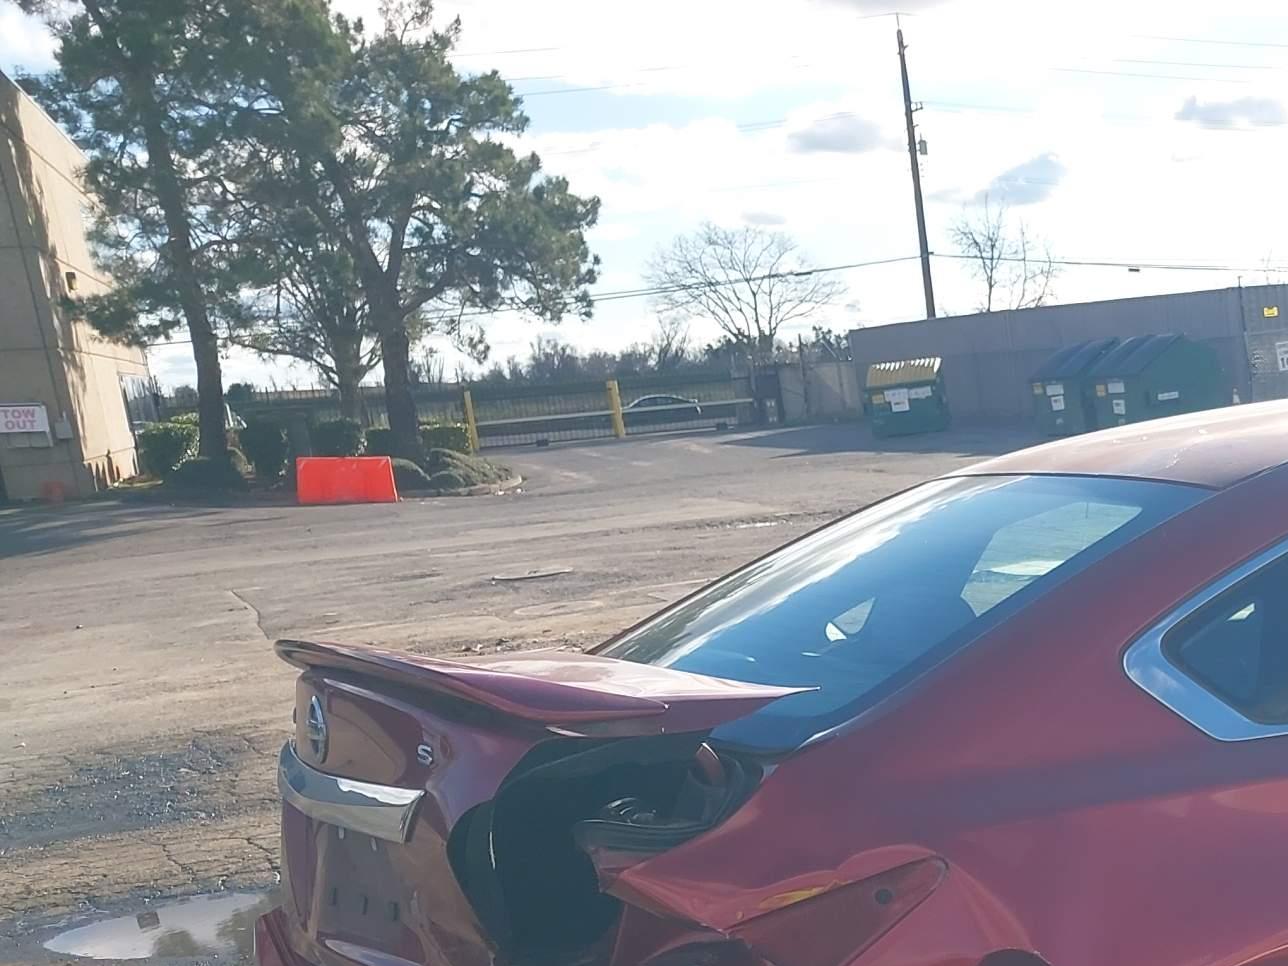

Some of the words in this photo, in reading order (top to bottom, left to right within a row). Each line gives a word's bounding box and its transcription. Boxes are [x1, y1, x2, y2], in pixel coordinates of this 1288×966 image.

[0, 409, 35, 419] TOW
[4, 420, 36, 430] OUT
[418, 744, 432, 766] S
